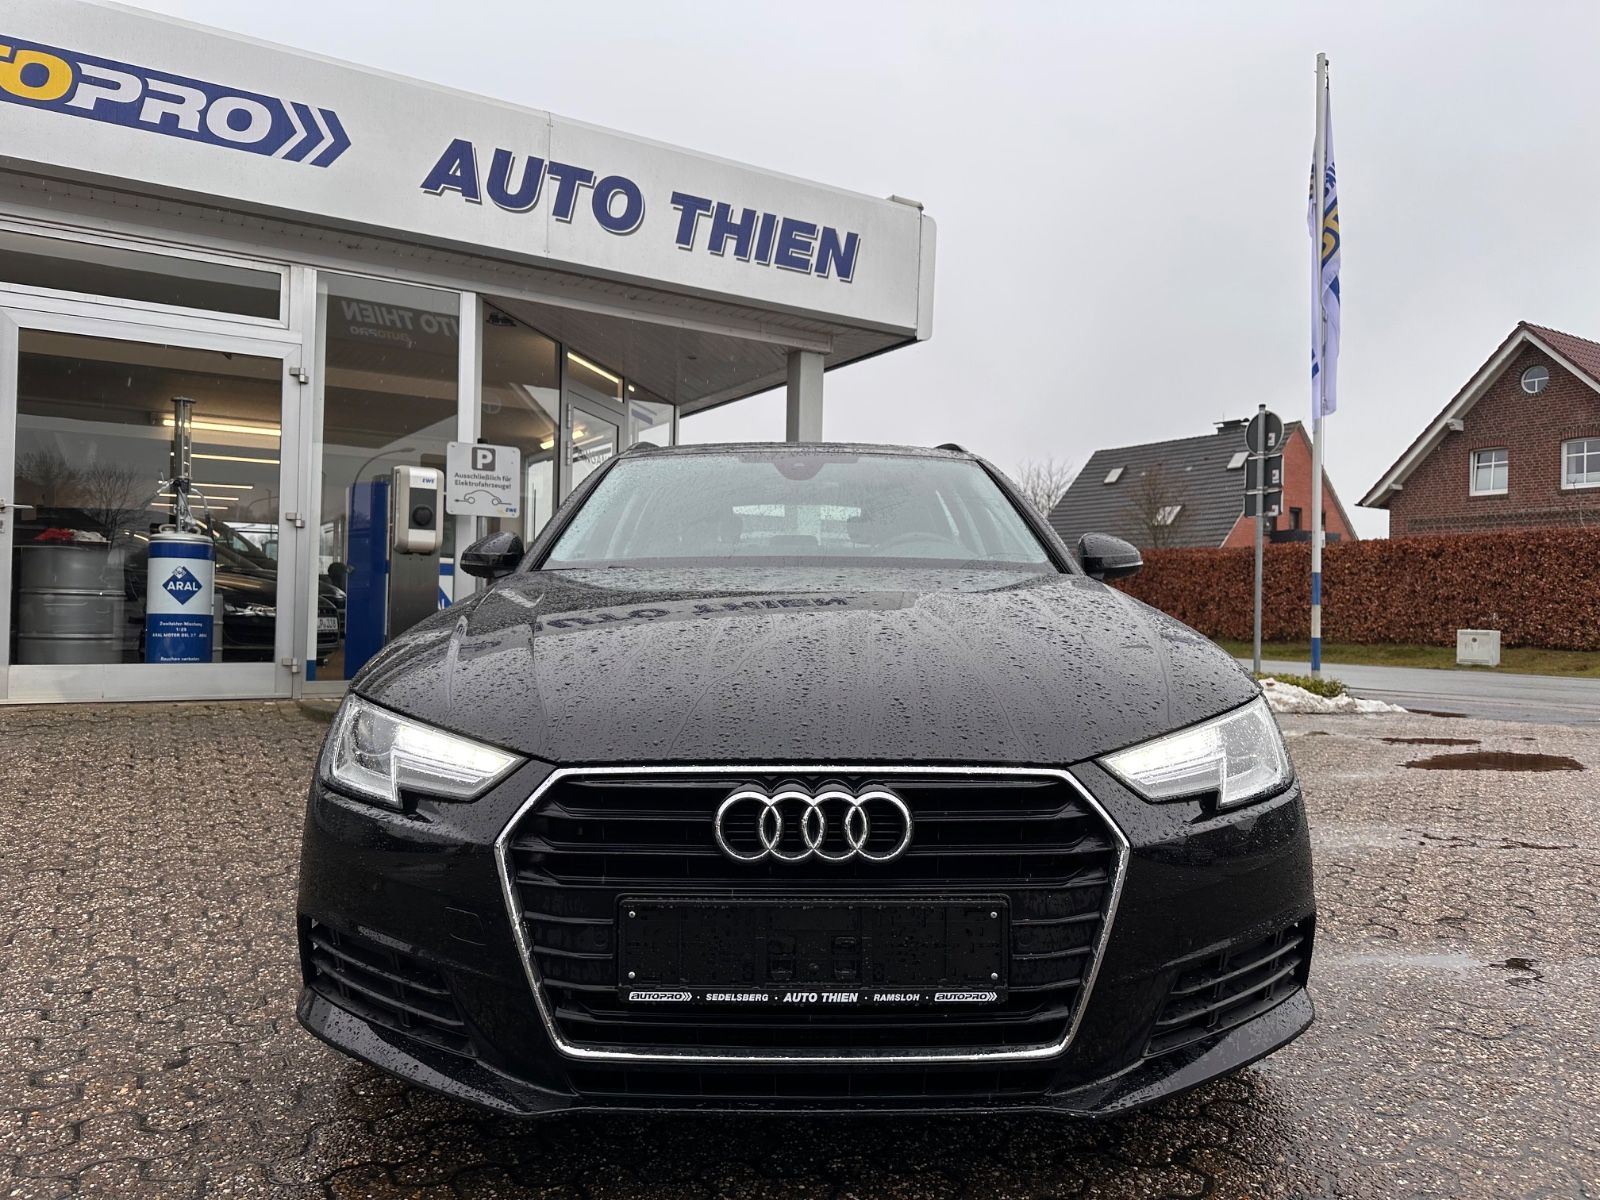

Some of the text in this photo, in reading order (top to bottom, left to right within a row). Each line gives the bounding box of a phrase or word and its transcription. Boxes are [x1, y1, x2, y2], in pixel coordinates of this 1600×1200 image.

[0, 44, 272, 144] OPRO
[420, 138, 861, 284] AUTO THIEN
[476, 449, 493, 469] P
[167, 582, 198, 591] ARAL
[705, 993, 769, 1002] SEDELSBERG
[783, 992, 818, 1003] AUTO
[821, 992, 858, 1003] THIEN
[873, 993, 920, 1002] RAMSLOH
